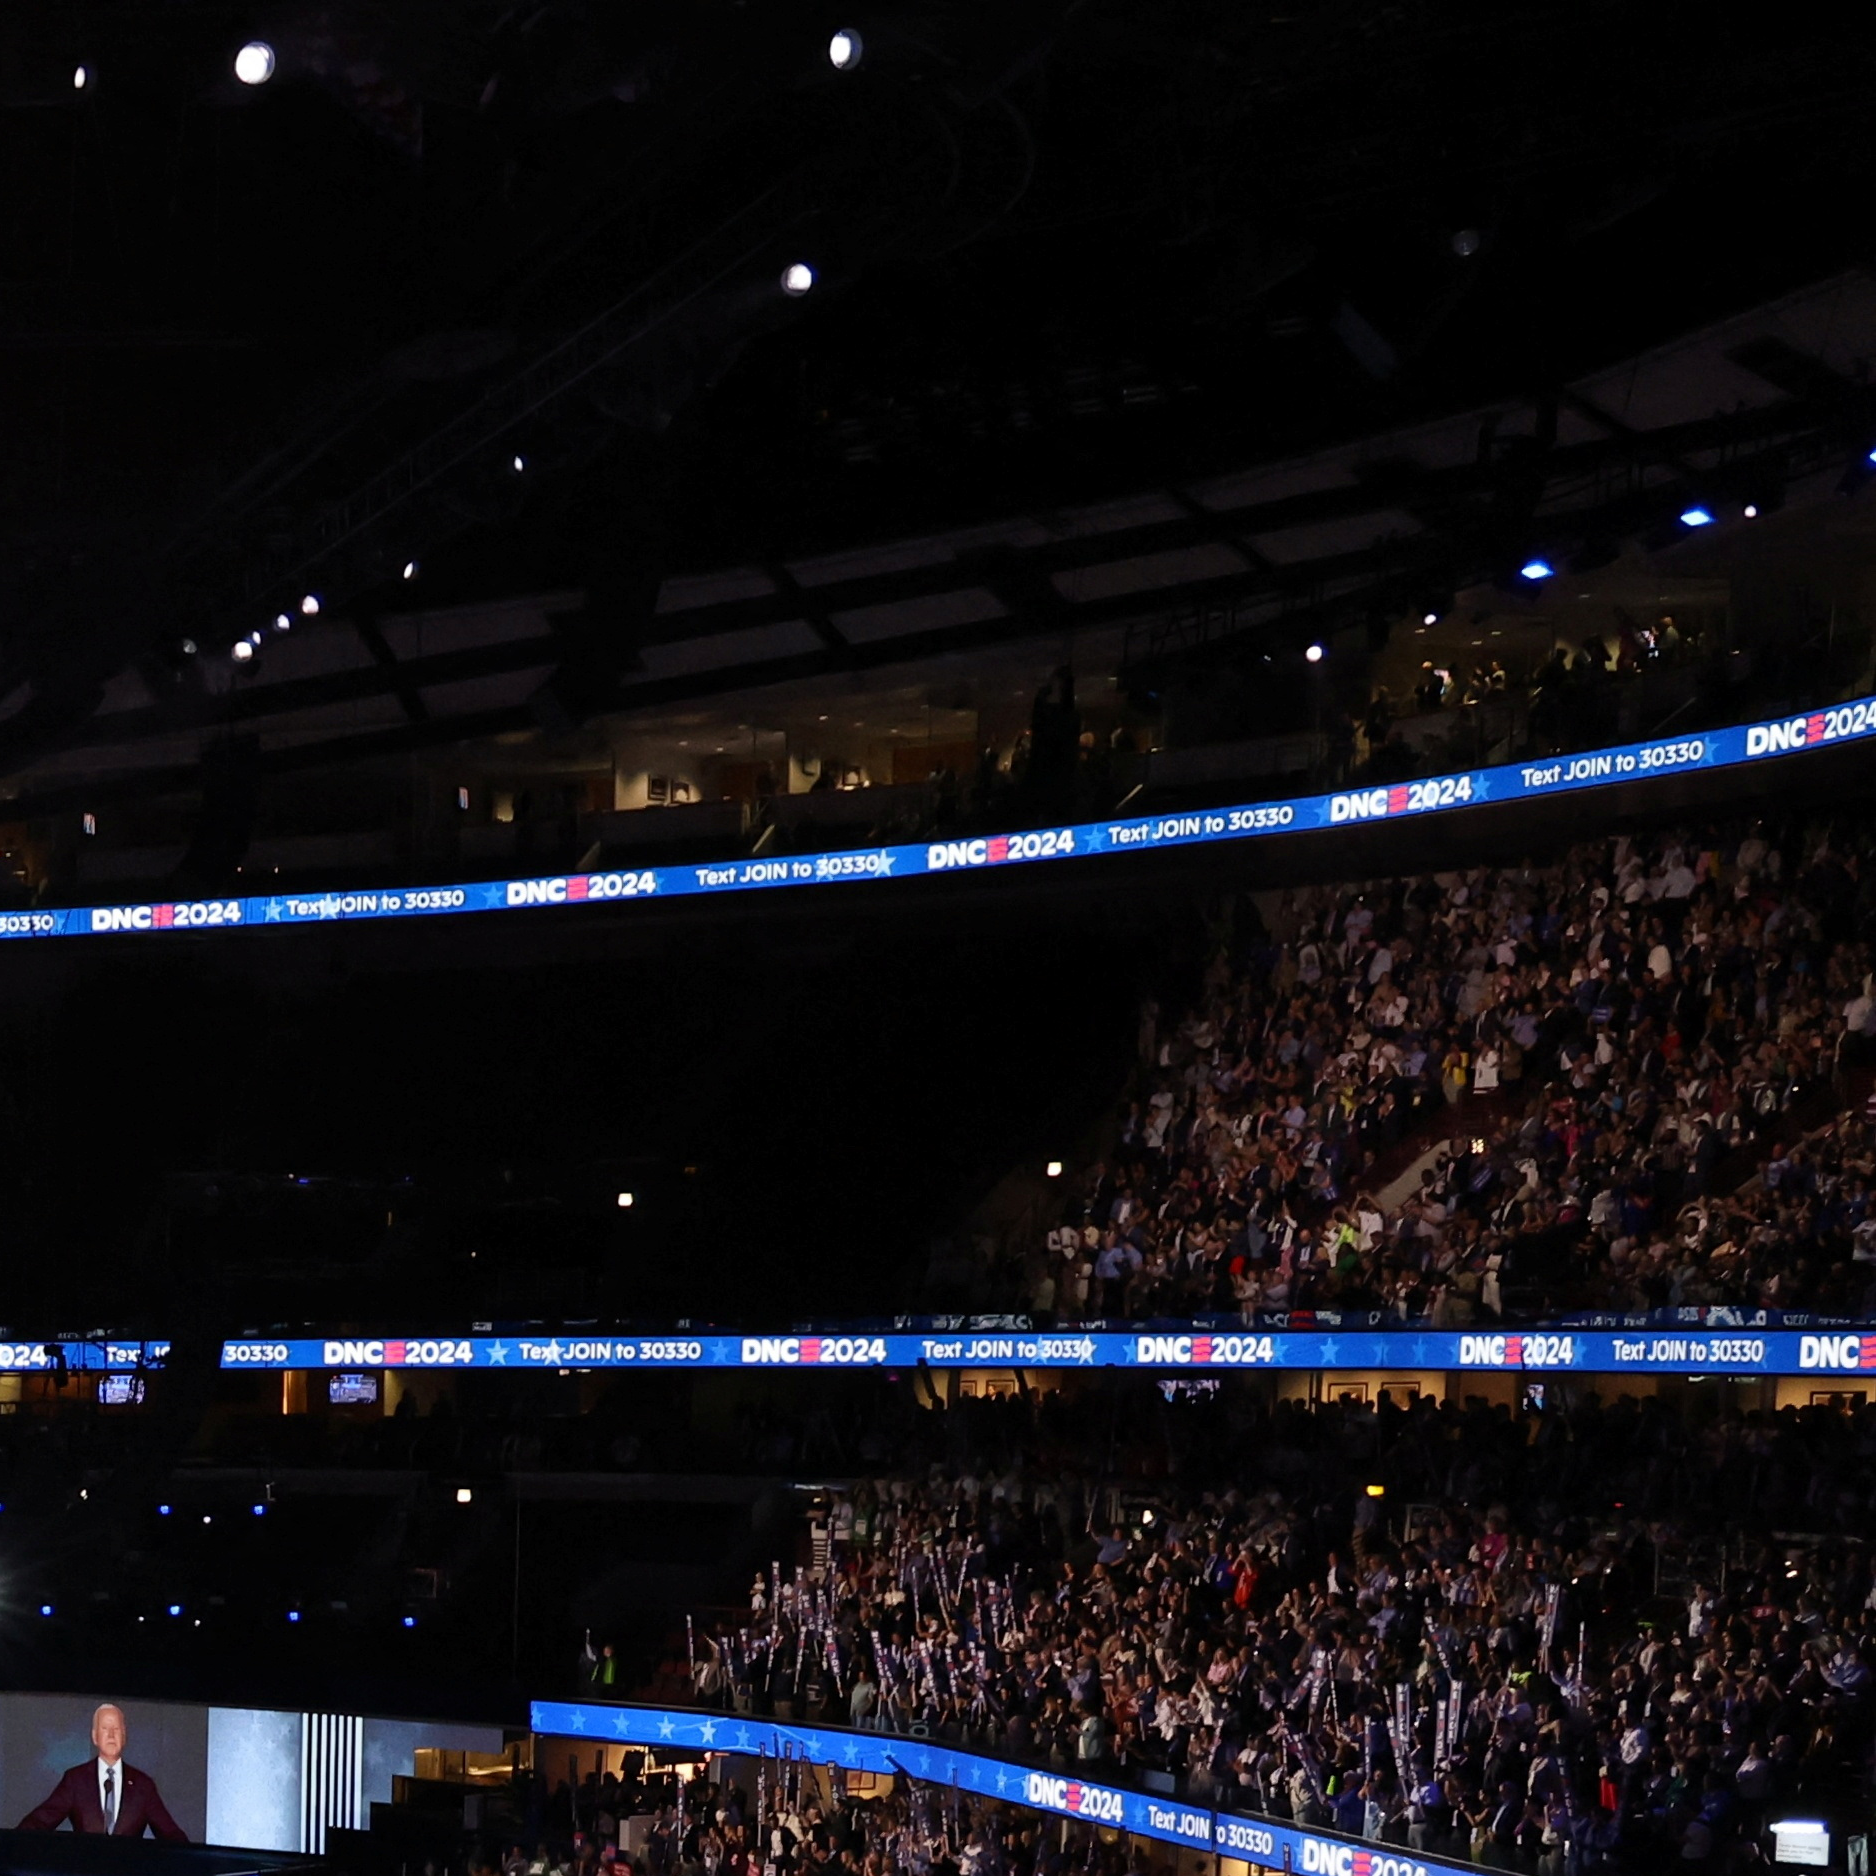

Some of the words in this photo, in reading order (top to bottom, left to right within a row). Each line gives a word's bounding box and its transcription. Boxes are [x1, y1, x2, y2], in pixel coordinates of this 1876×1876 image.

[1522, 765, 1561, 787] Text
[1564, 756, 1611, 780] JOIN
[1616, 755, 1635, 772] to
[1639, 741, 1703, 768] 30330
[696, 868, 736, 885] Text
[740, 863, 787, 882] JOIN
[792, 863, 812, 877] to
[817, 855, 879, 875] 30330
[922, 1341, 960, 1358] Text
[966, 1340, 1012, 1358] JOIN
[1017, 1341, 1036, 1357] to
[1042, 1340, 1091, 1358] 30330
